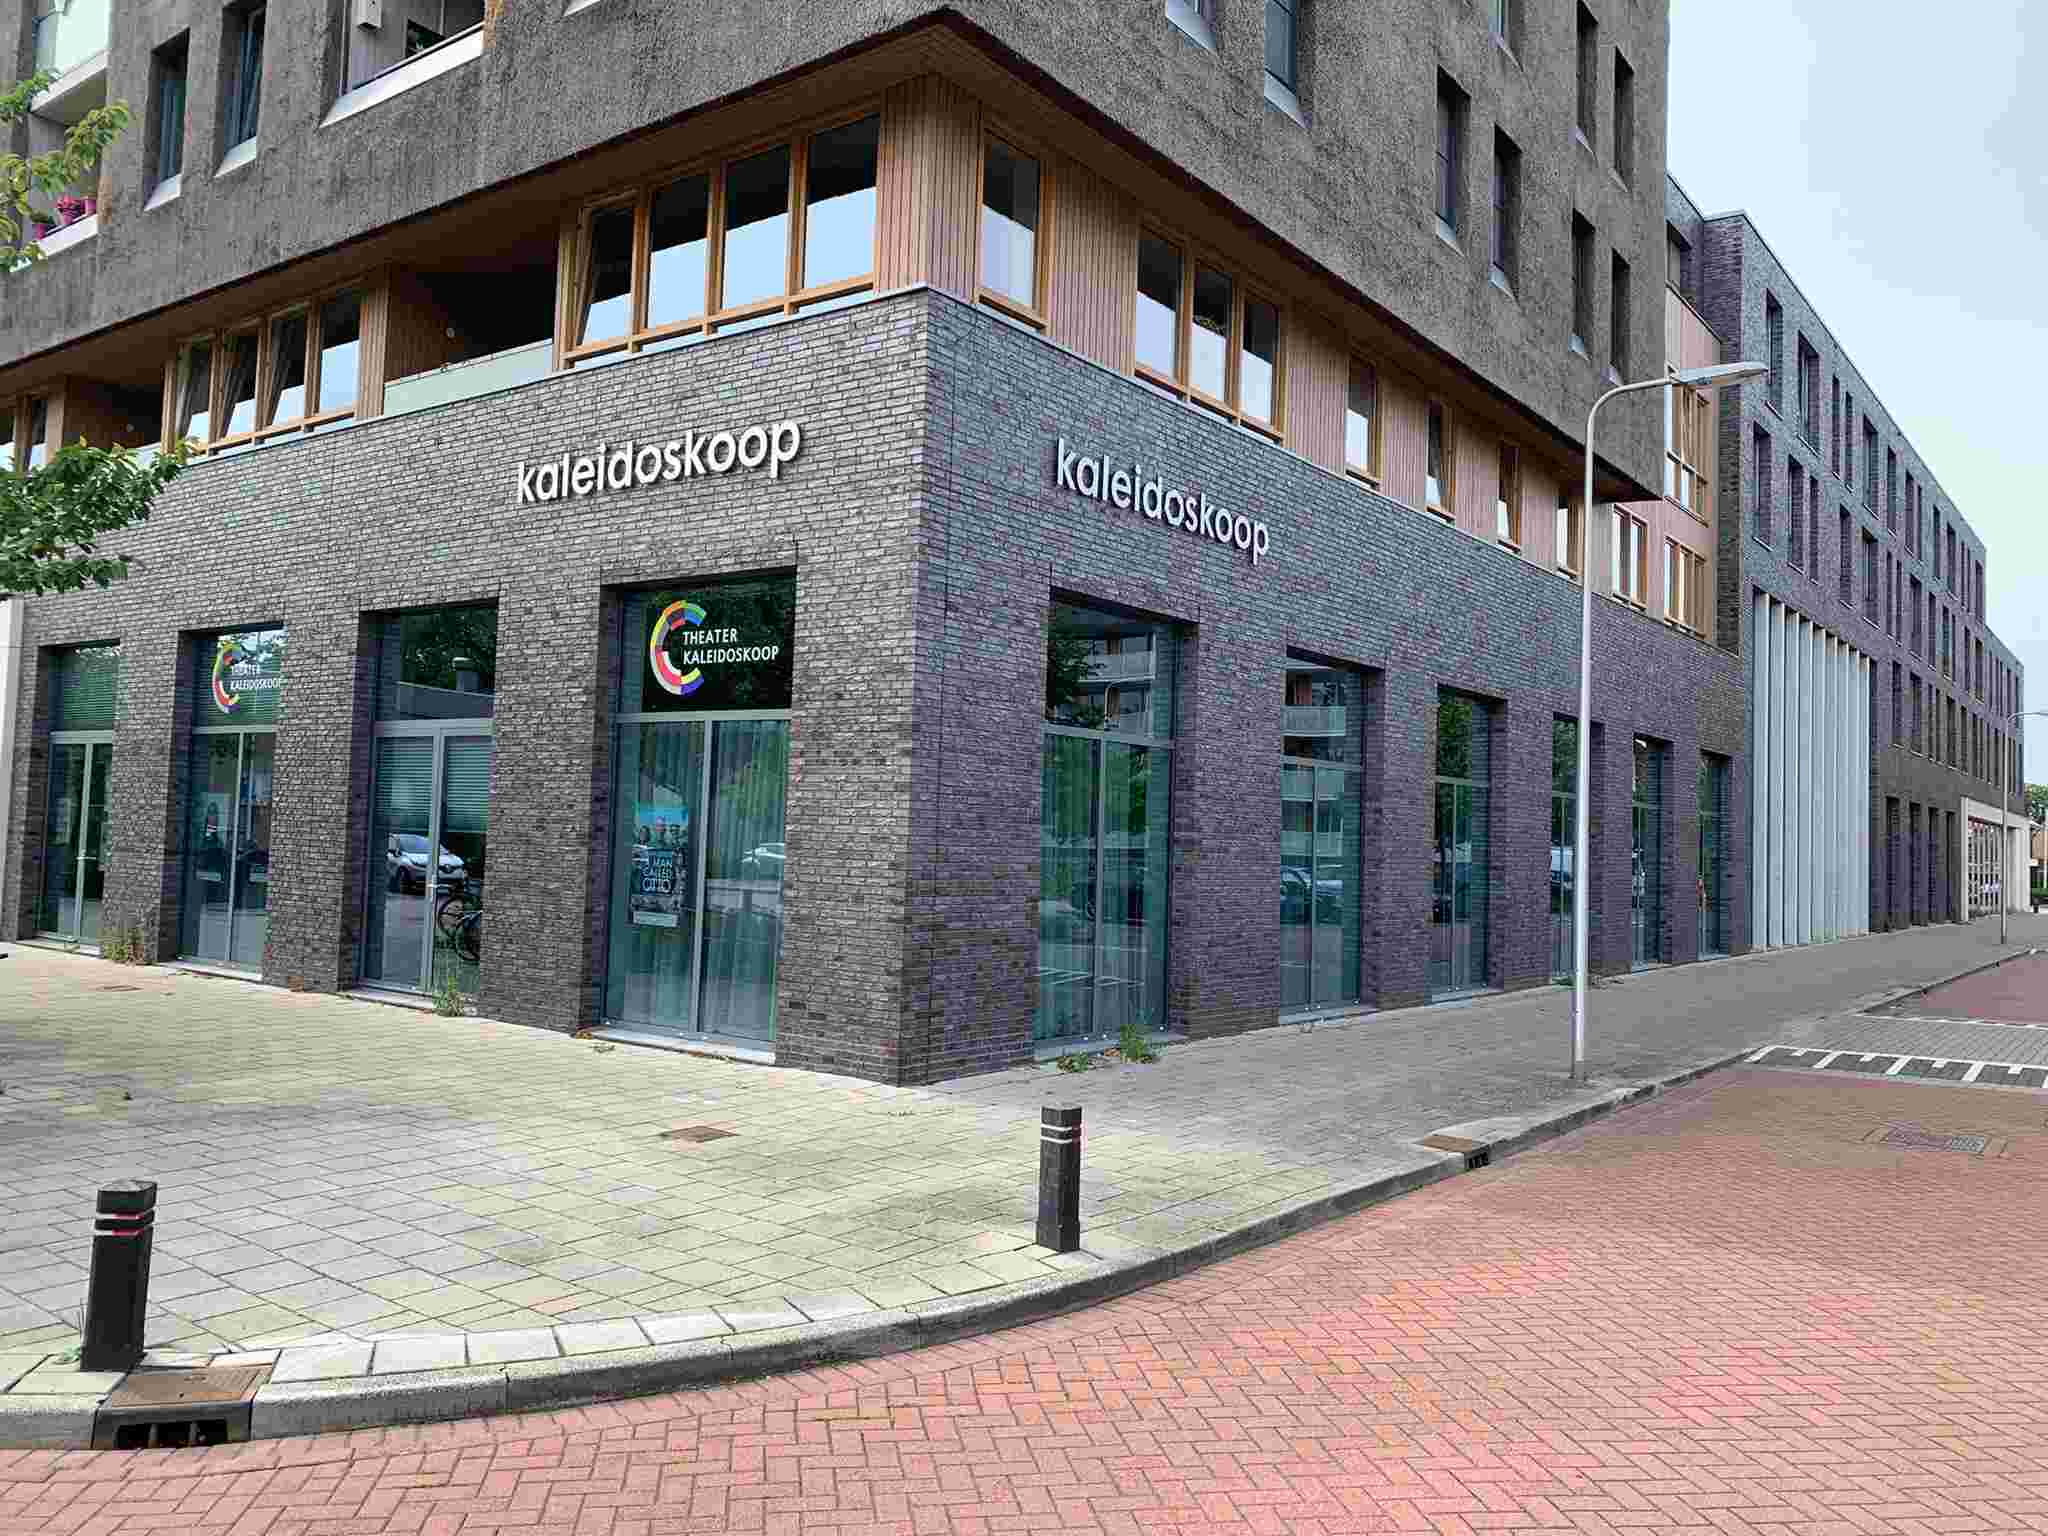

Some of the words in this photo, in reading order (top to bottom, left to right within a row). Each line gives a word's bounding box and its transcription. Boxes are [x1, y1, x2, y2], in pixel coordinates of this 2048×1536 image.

[517, 420, 802, 503] kaleidoskoop
[1056, 437, 1270, 566] kaleidoskoop
[682, 628, 738, 645] THEATER
[683, 645, 779, 665] KALEIDOSKOOP
